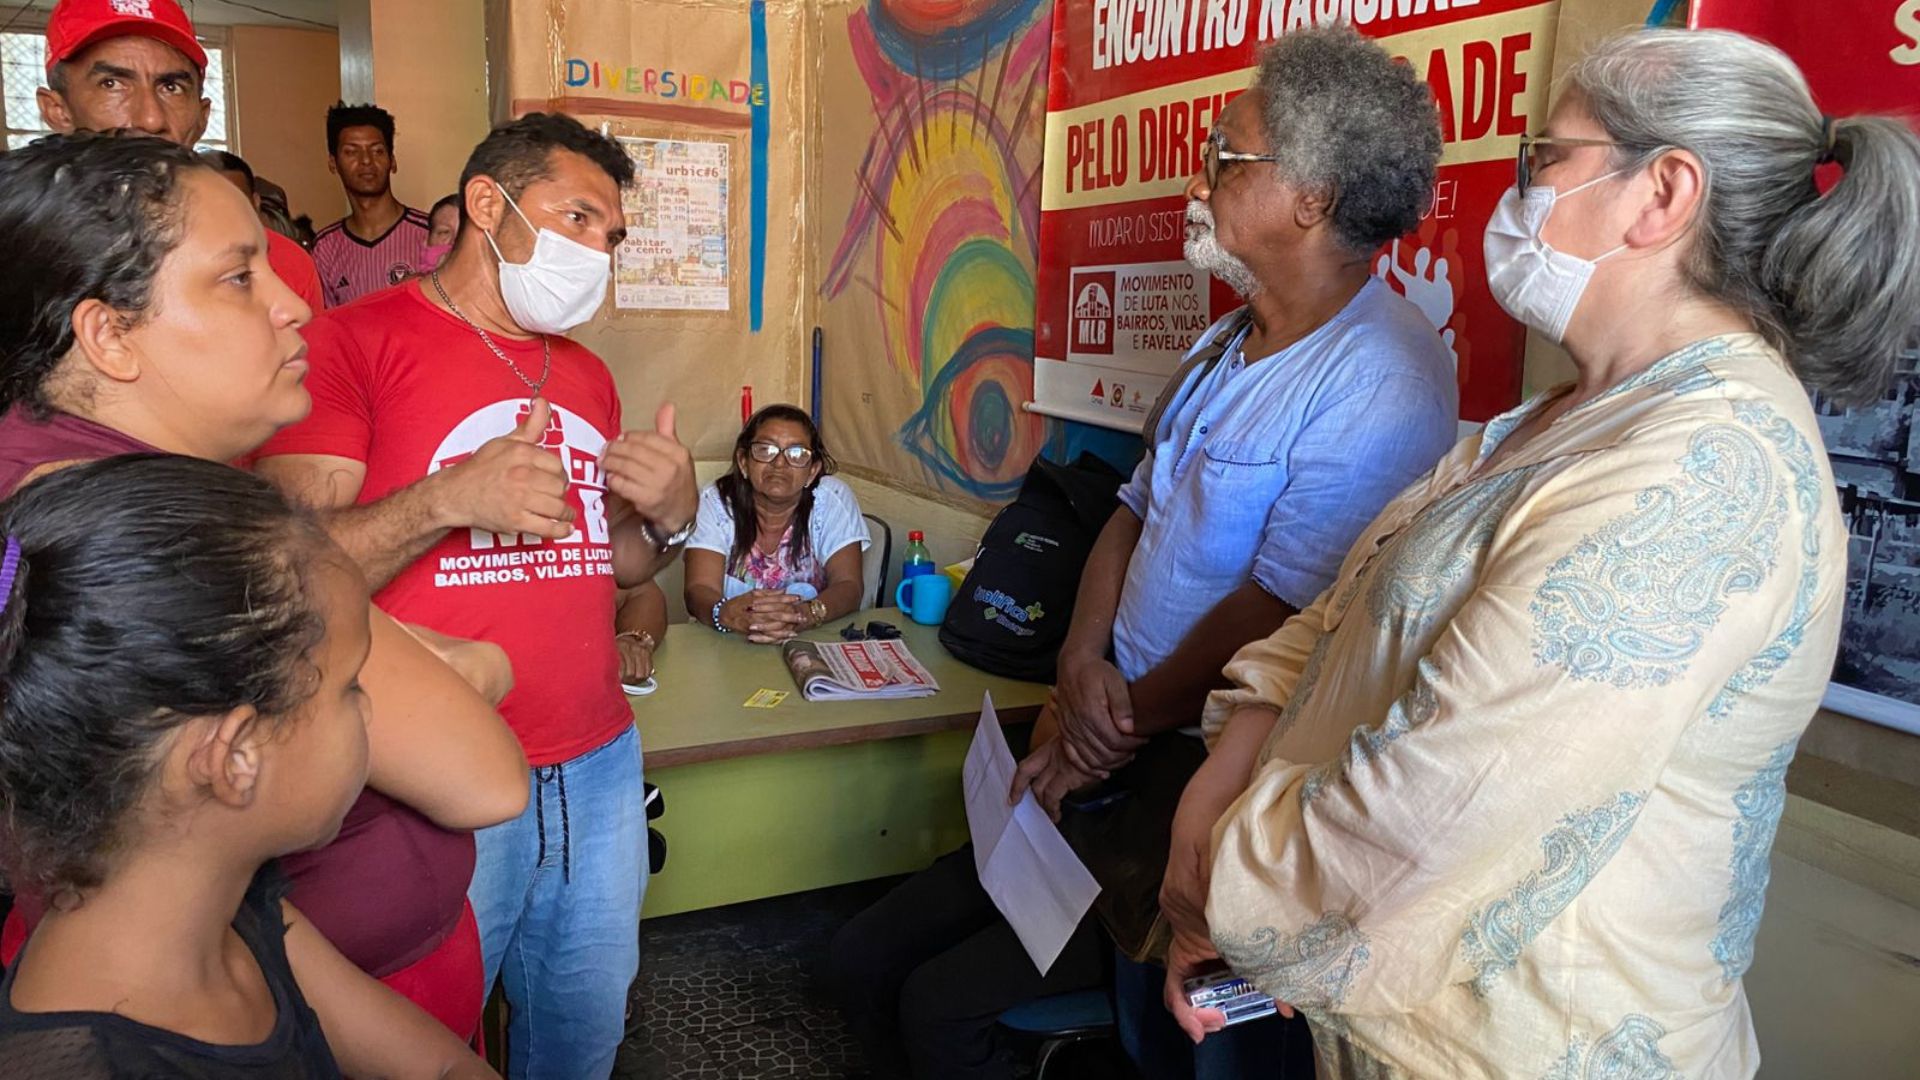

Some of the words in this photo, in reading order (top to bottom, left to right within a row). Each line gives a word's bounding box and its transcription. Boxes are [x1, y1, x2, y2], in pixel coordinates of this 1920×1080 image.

[1093, 0, 1249, 70] ENCONTRO
[565, 59, 765, 106] DIVERSIDADE
[1066, 114, 1128, 193] PELO
[1139, 88, 1249, 183] DIRE
[1392, 32, 1531, 143] ADE
[666, 165, 719, 177] urbic#6
[1089, 216, 1133, 248] MUDAR
[1135, 214, 1145, 244] O
[624, 238, 667, 247] habitar
[636, 246, 672, 254] centro
[1121, 274, 1194, 292] MOVIMENTO
[1124, 296, 1138, 311] DE
[1141, 295, 1168, 311] LUTA
[1172, 294, 1199, 311] NOS
[1079, 319, 1106, 345] MLB
[1117, 315, 1168, 332] BAIRROS,
[1171, 315, 1206, 331] VILAS
[1133, 334, 1139, 349] E
[1142, 335, 1192, 351] FAVELAS
[439, 550, 557, 571] MOVIMENTO
[561, 549, 580, 562] DE
[434, 567, 530, 587] BAIRROS,
[535, 563, 582, 580] VILAS
[585, 563, 594, 576] E
